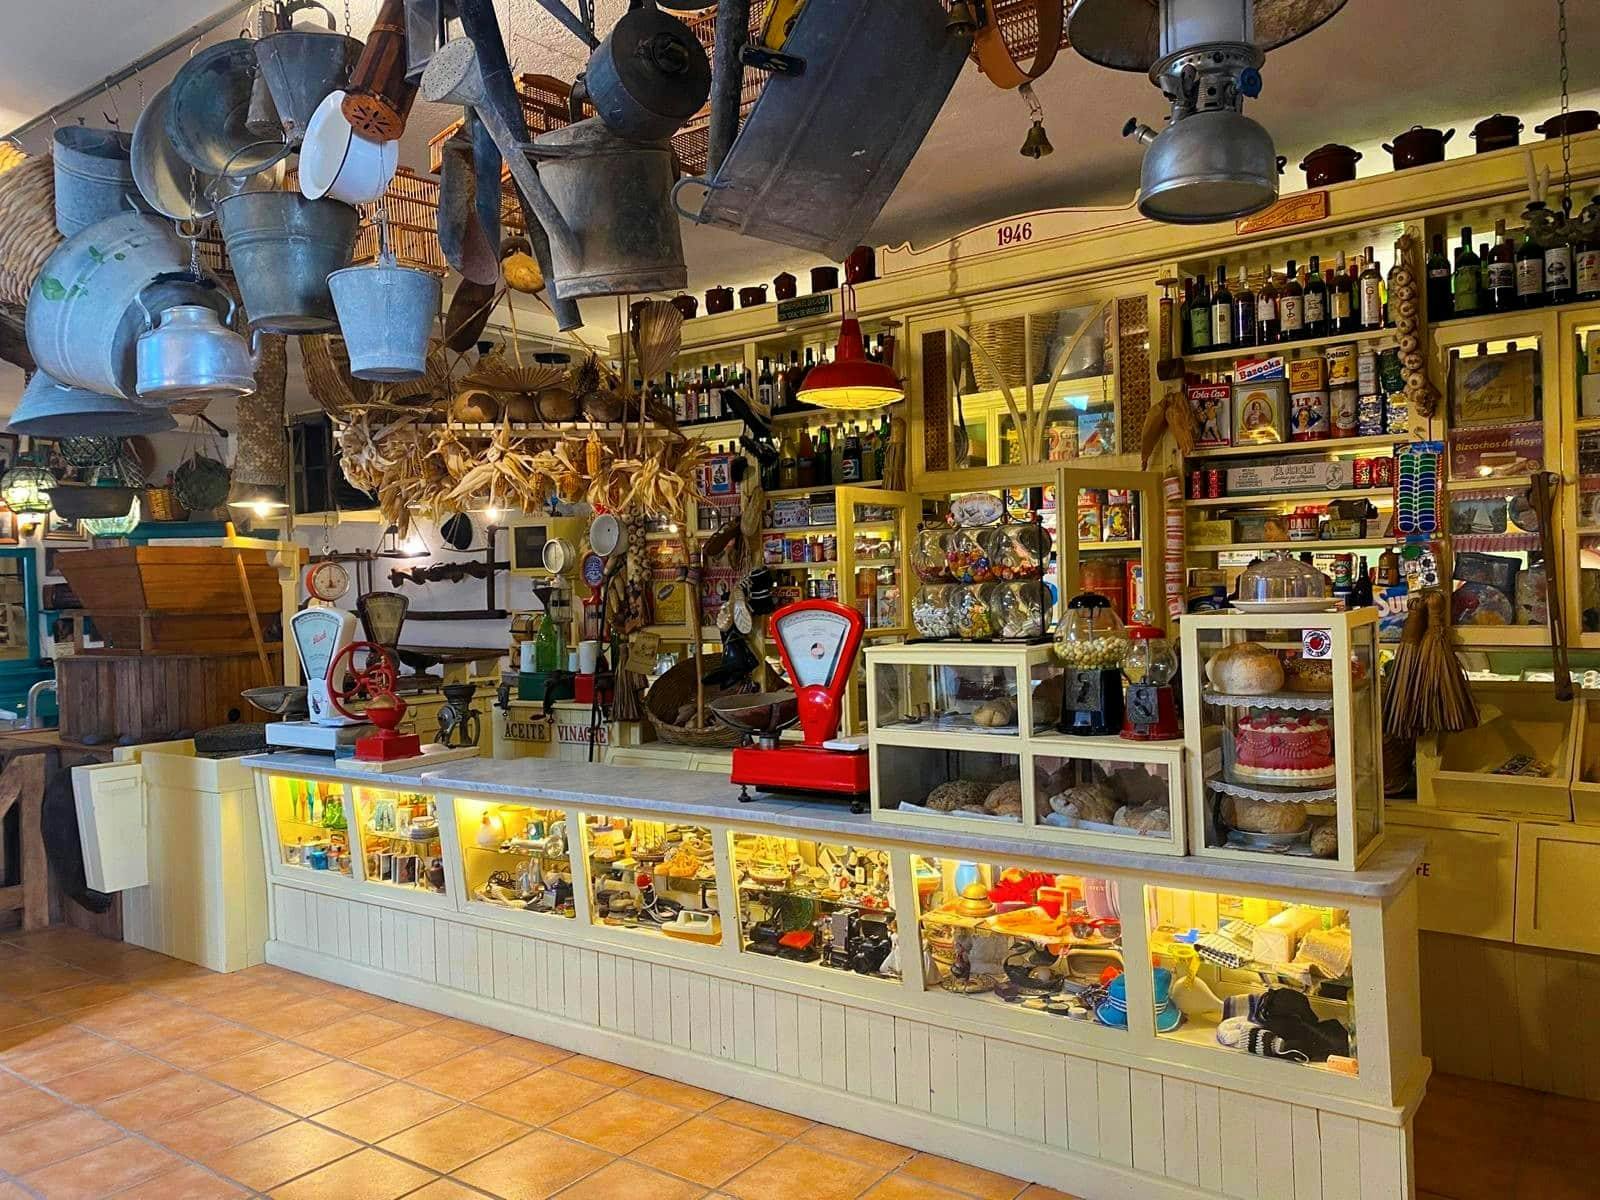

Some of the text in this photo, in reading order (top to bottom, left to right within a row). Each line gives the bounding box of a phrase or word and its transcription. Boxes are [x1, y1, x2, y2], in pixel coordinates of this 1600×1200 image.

[997, 222, 1032, 246] 1946
[1239, 359, 1281, 380] Bazooka
[1192, 388, 1226, 399] Cola Cao
[1455, 440, 1500, 452] Bizcochos
[1501, 440, 1513, 448] de
[504, 722, 545, 740] ACEITE
